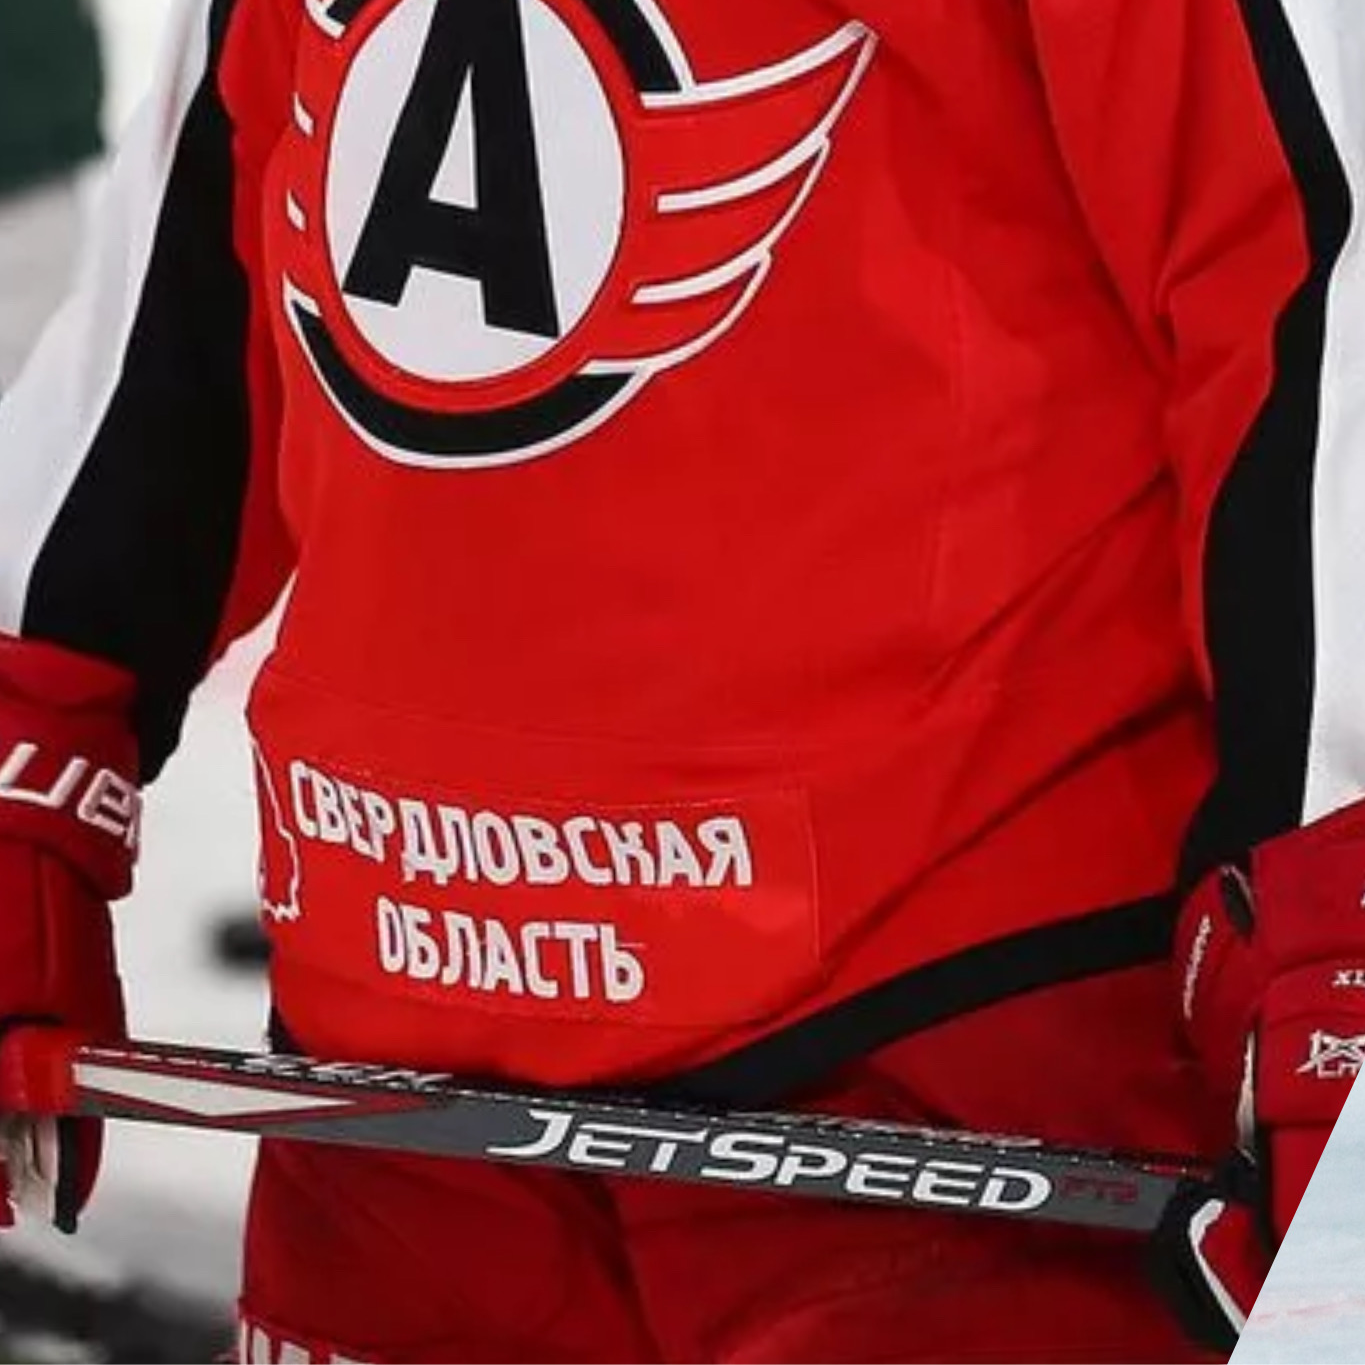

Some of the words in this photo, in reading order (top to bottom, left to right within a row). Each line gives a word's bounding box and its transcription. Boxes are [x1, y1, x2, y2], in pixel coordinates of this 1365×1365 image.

[290, 760, 753, 889] СВЕРДЛОВСКАЯ
[377, 897, 645, 1003] ОБЛАСТЬ
[487, 1107, 1052, 1211] JETSPEED
